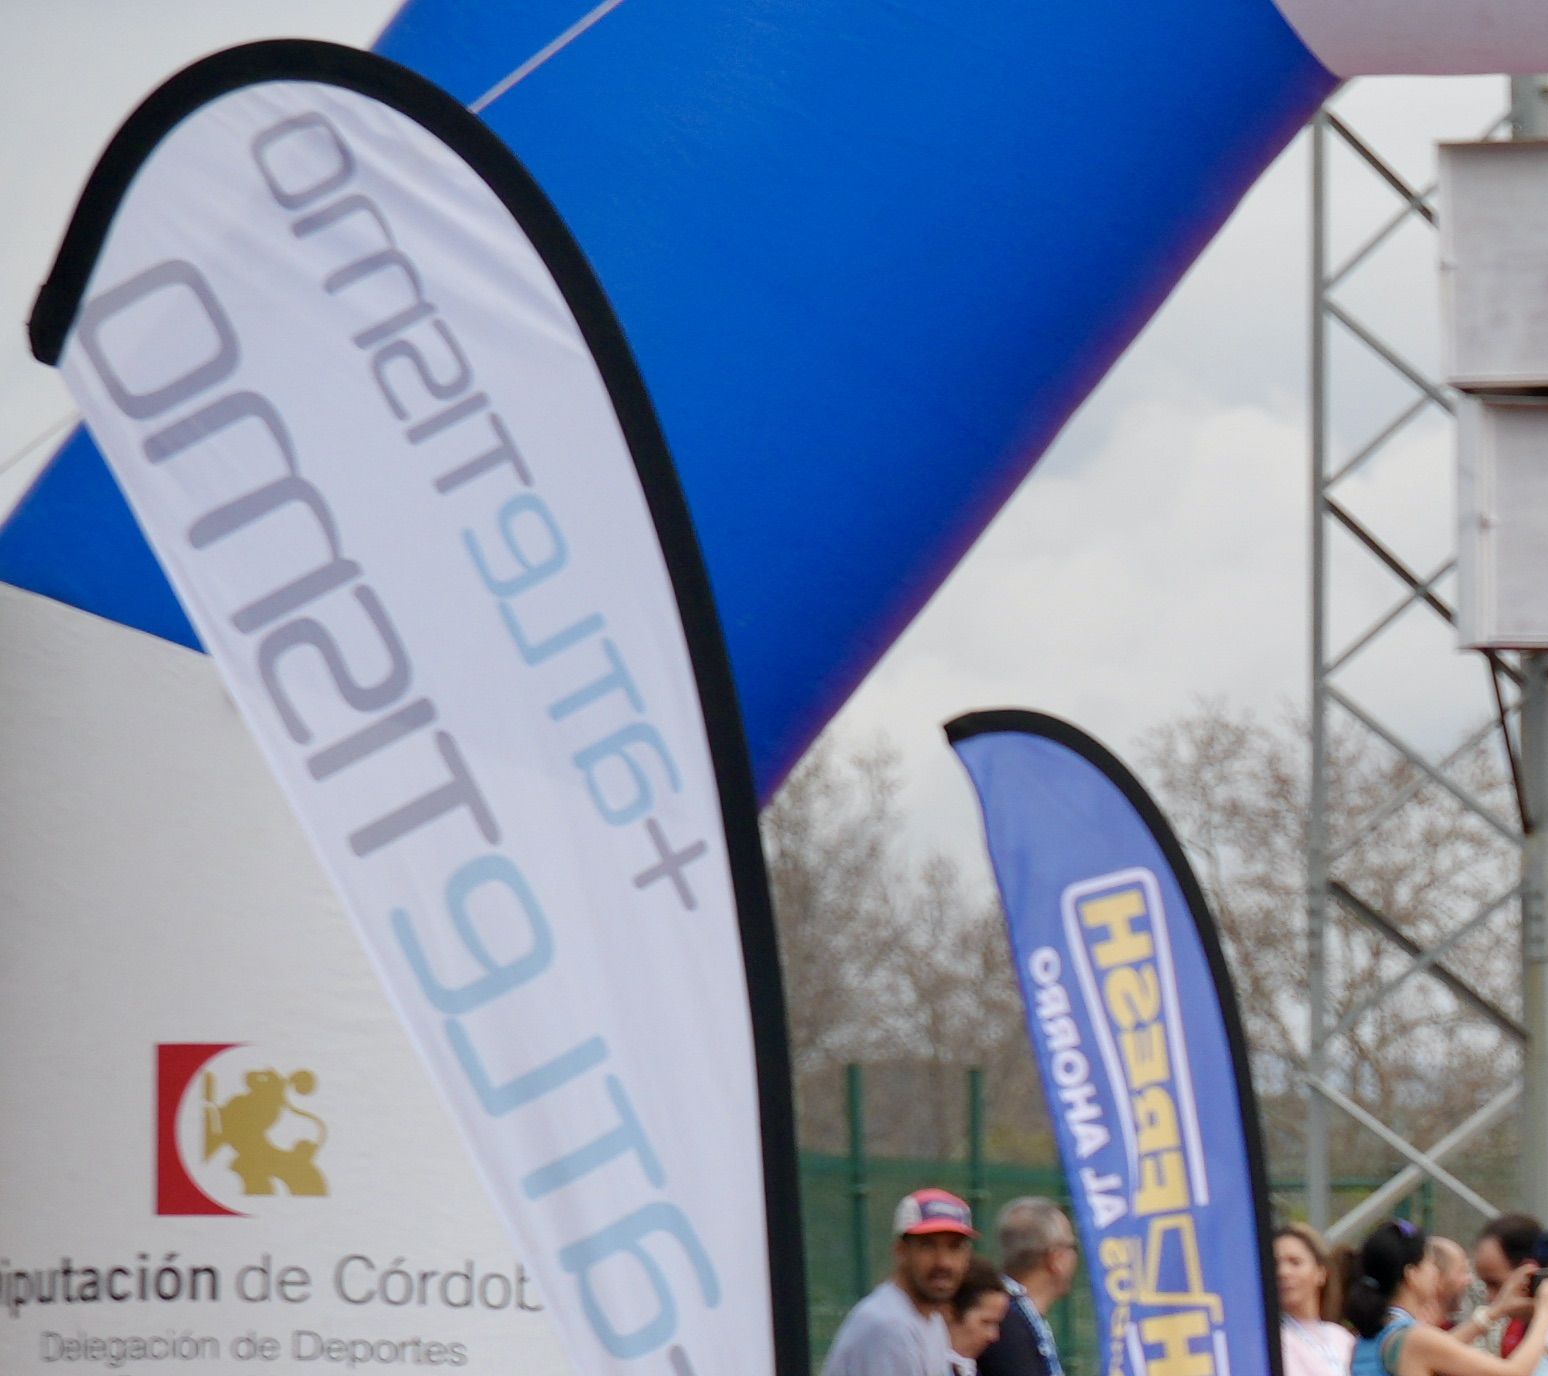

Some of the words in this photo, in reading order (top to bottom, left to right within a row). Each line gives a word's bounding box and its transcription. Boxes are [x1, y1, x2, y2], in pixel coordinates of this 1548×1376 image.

[0, 1254, 219, 1316] iputación
[236, 1255, 311, 1304] de
[40, 1329, 220, 1367] Delegación
[231, 1331, 280, 1361] de
[291, 1330, 467, 1367] Deportes
